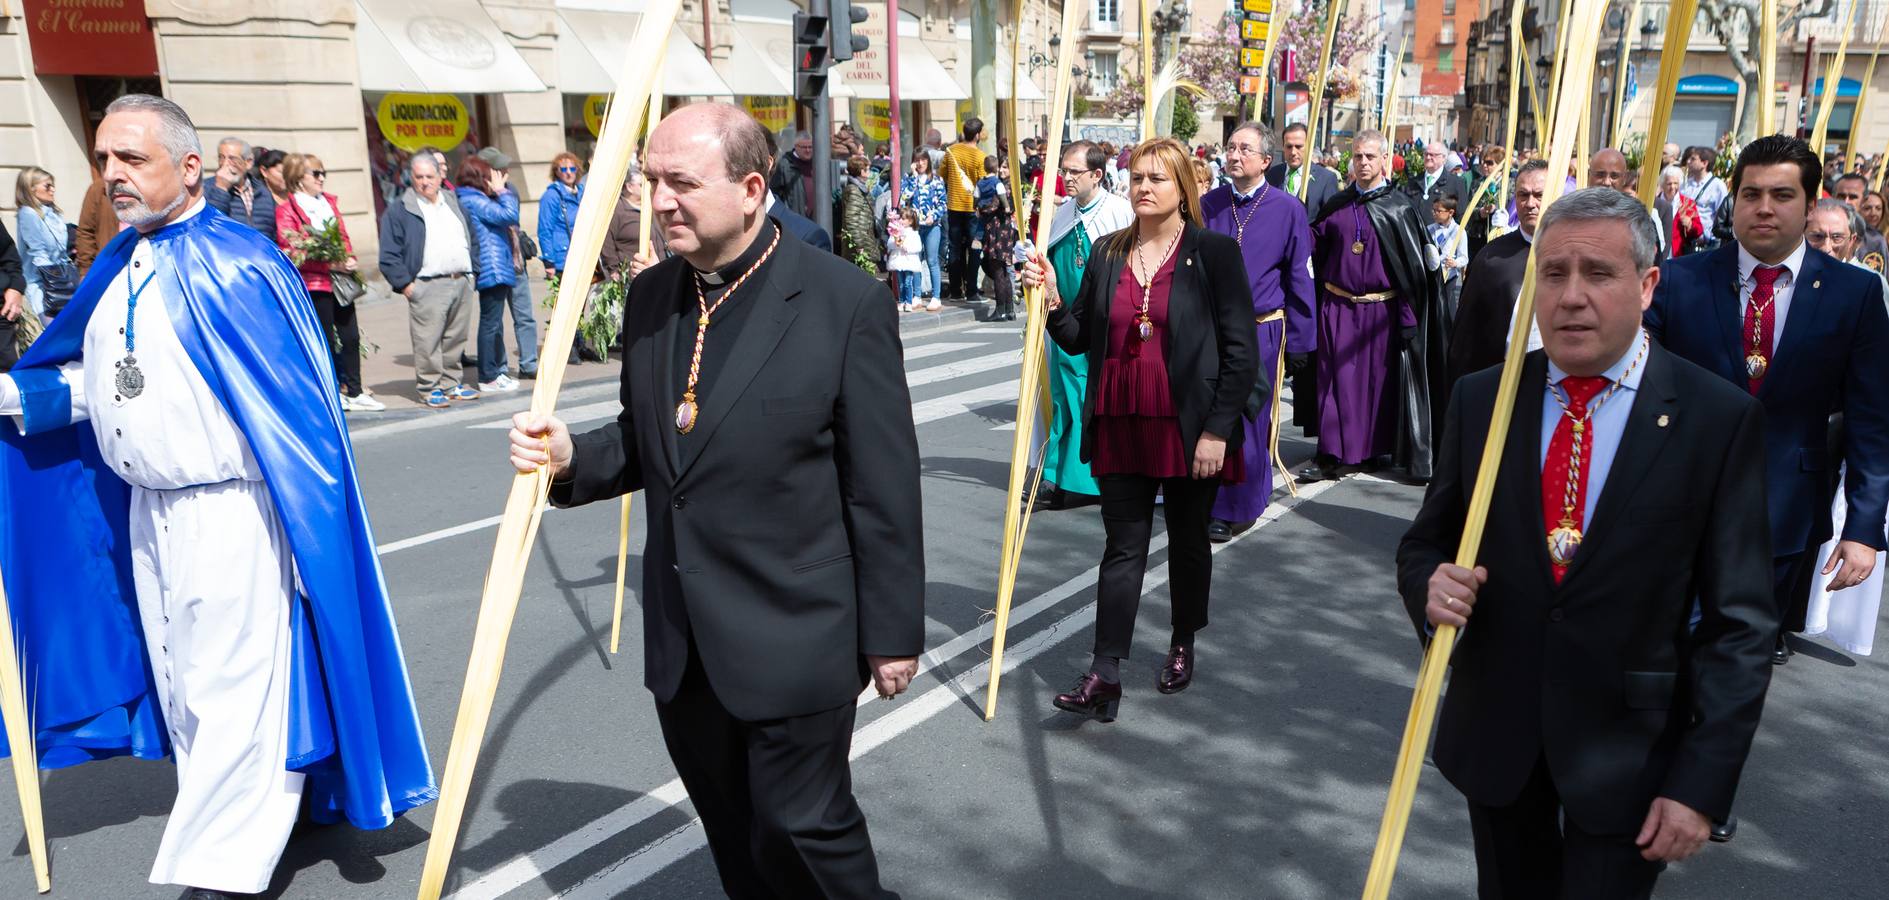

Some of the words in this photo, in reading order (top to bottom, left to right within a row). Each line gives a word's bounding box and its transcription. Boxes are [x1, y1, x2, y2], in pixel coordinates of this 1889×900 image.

[38, 9, 60, 32] El
[64, 10, 141, 32] Carmen
[855, 61, 872, 70] DEL
[846, 71, 882, 80] CARMEN
[396, 123, 418, 137] POR
[423, 124, 455, 137] CIERRE
